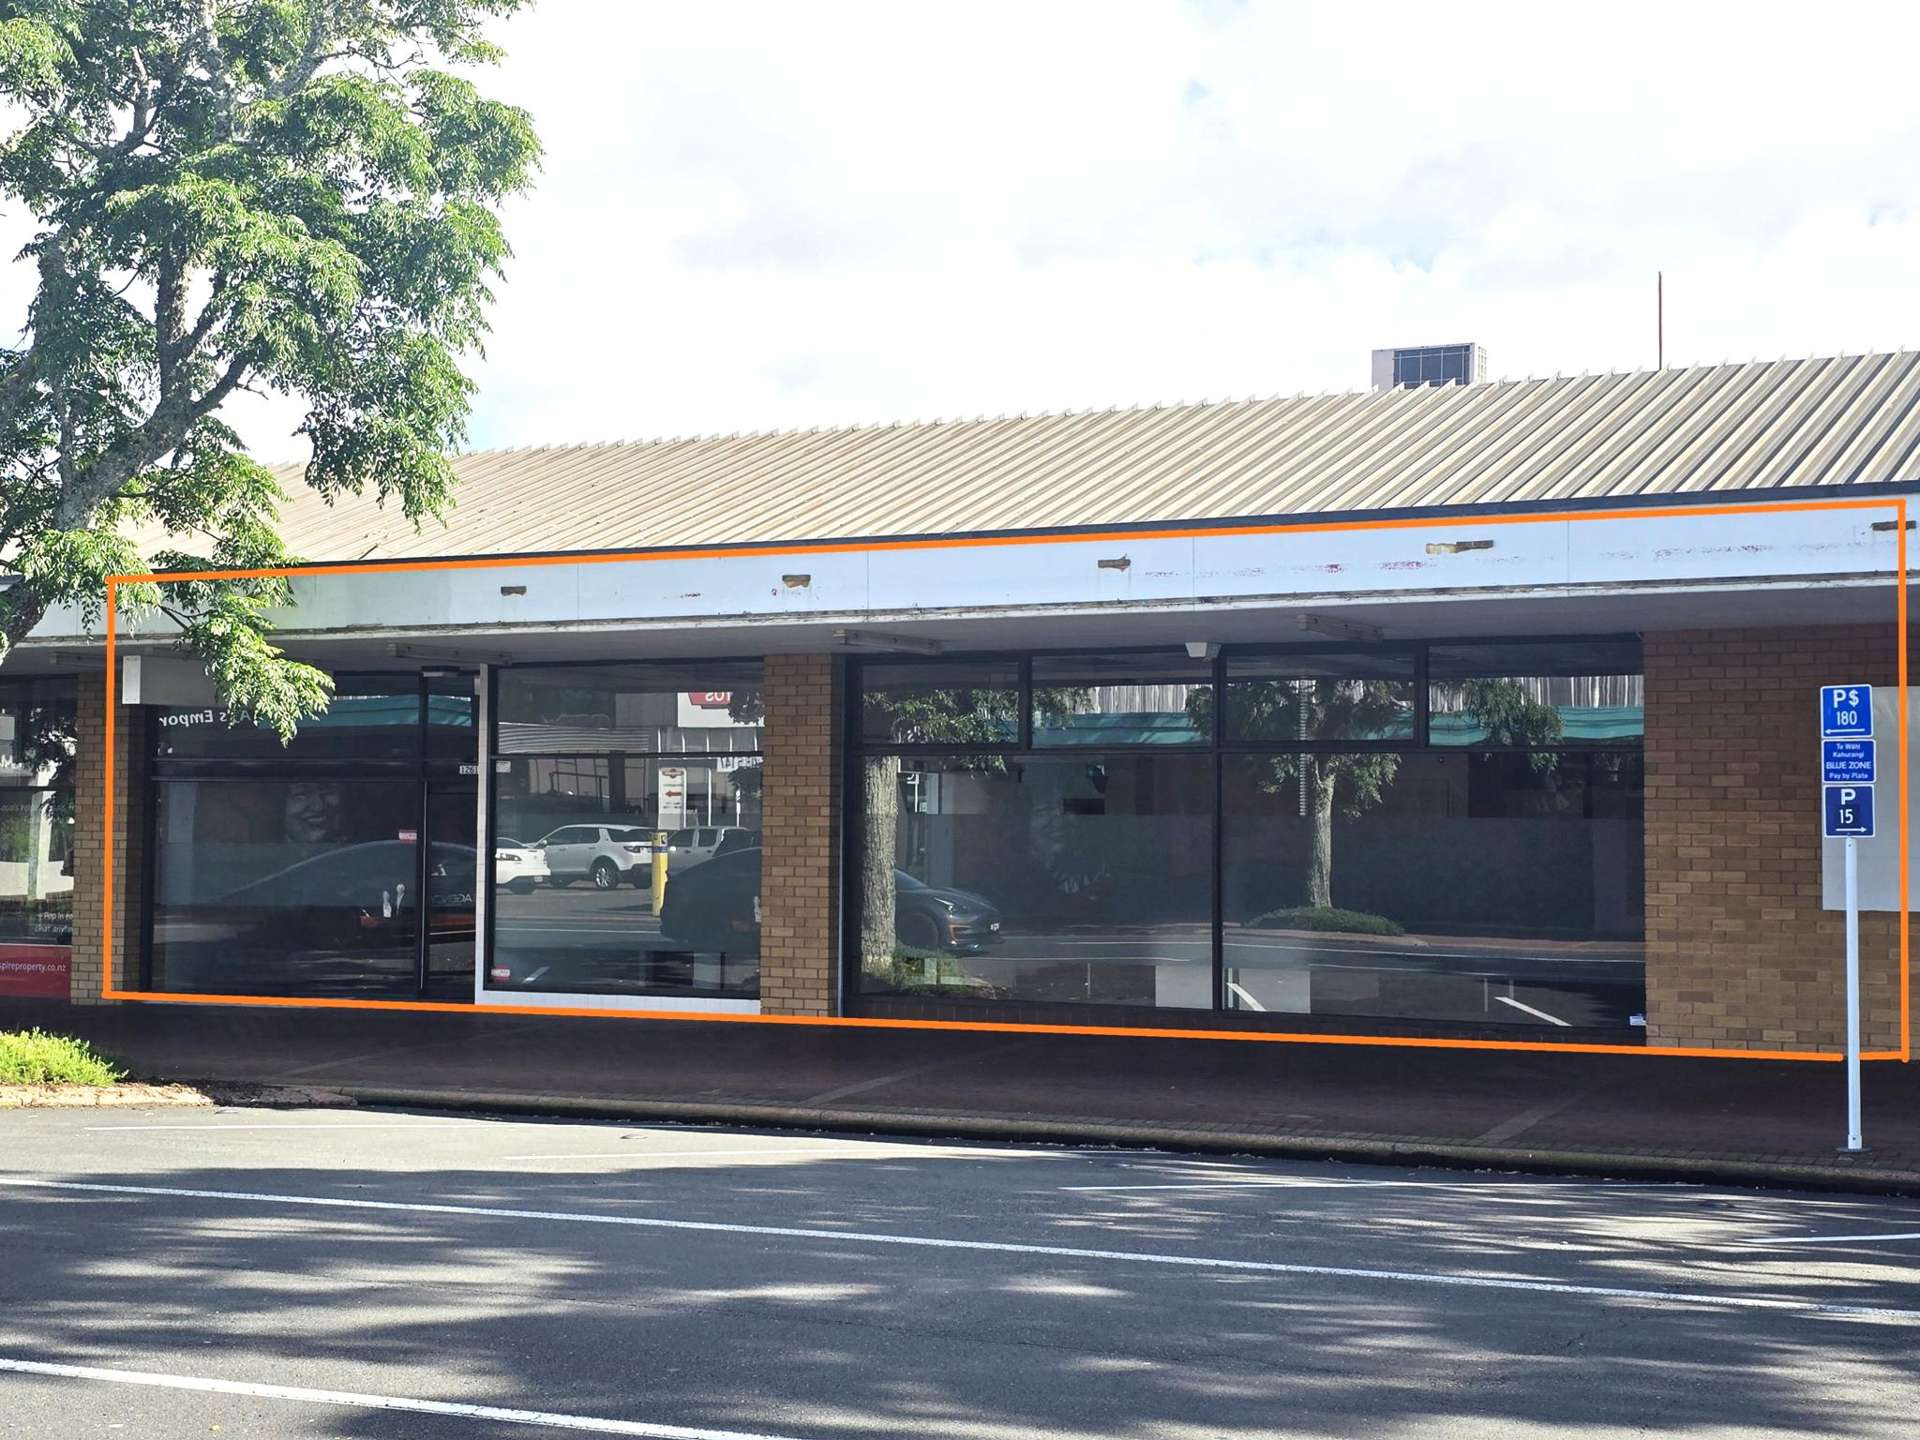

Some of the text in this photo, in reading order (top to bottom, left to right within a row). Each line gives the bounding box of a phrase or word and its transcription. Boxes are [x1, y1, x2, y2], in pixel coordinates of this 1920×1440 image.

[1836, 710, 1857, 725] 180
[1826, 761, 1872, 769] BLUE ZONE
[1829, 772, 1869, 780] Pay by Plate
[1840, 788, 1856, 805] P
[1839, 808, 1853, 824] 15
